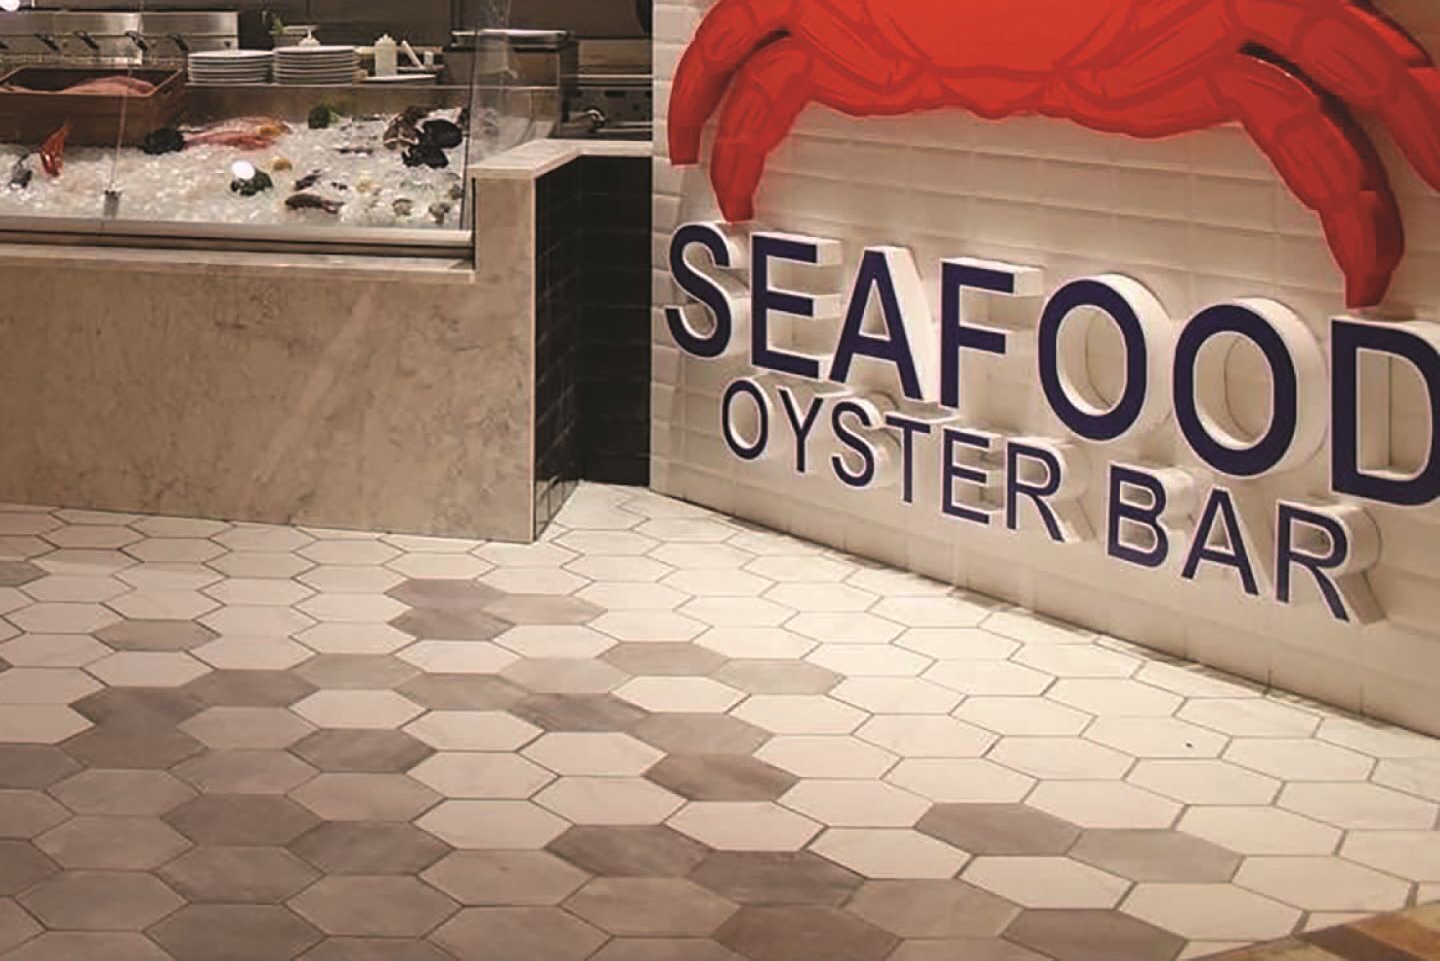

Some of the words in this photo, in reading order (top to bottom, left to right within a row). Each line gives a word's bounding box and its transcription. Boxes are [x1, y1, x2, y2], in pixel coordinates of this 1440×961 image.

[664, 223, 1440, 507] SEAFOOD
[721, 377, 1071, 543] OYSTER
[1108, 462, 1350, 622] BAR
